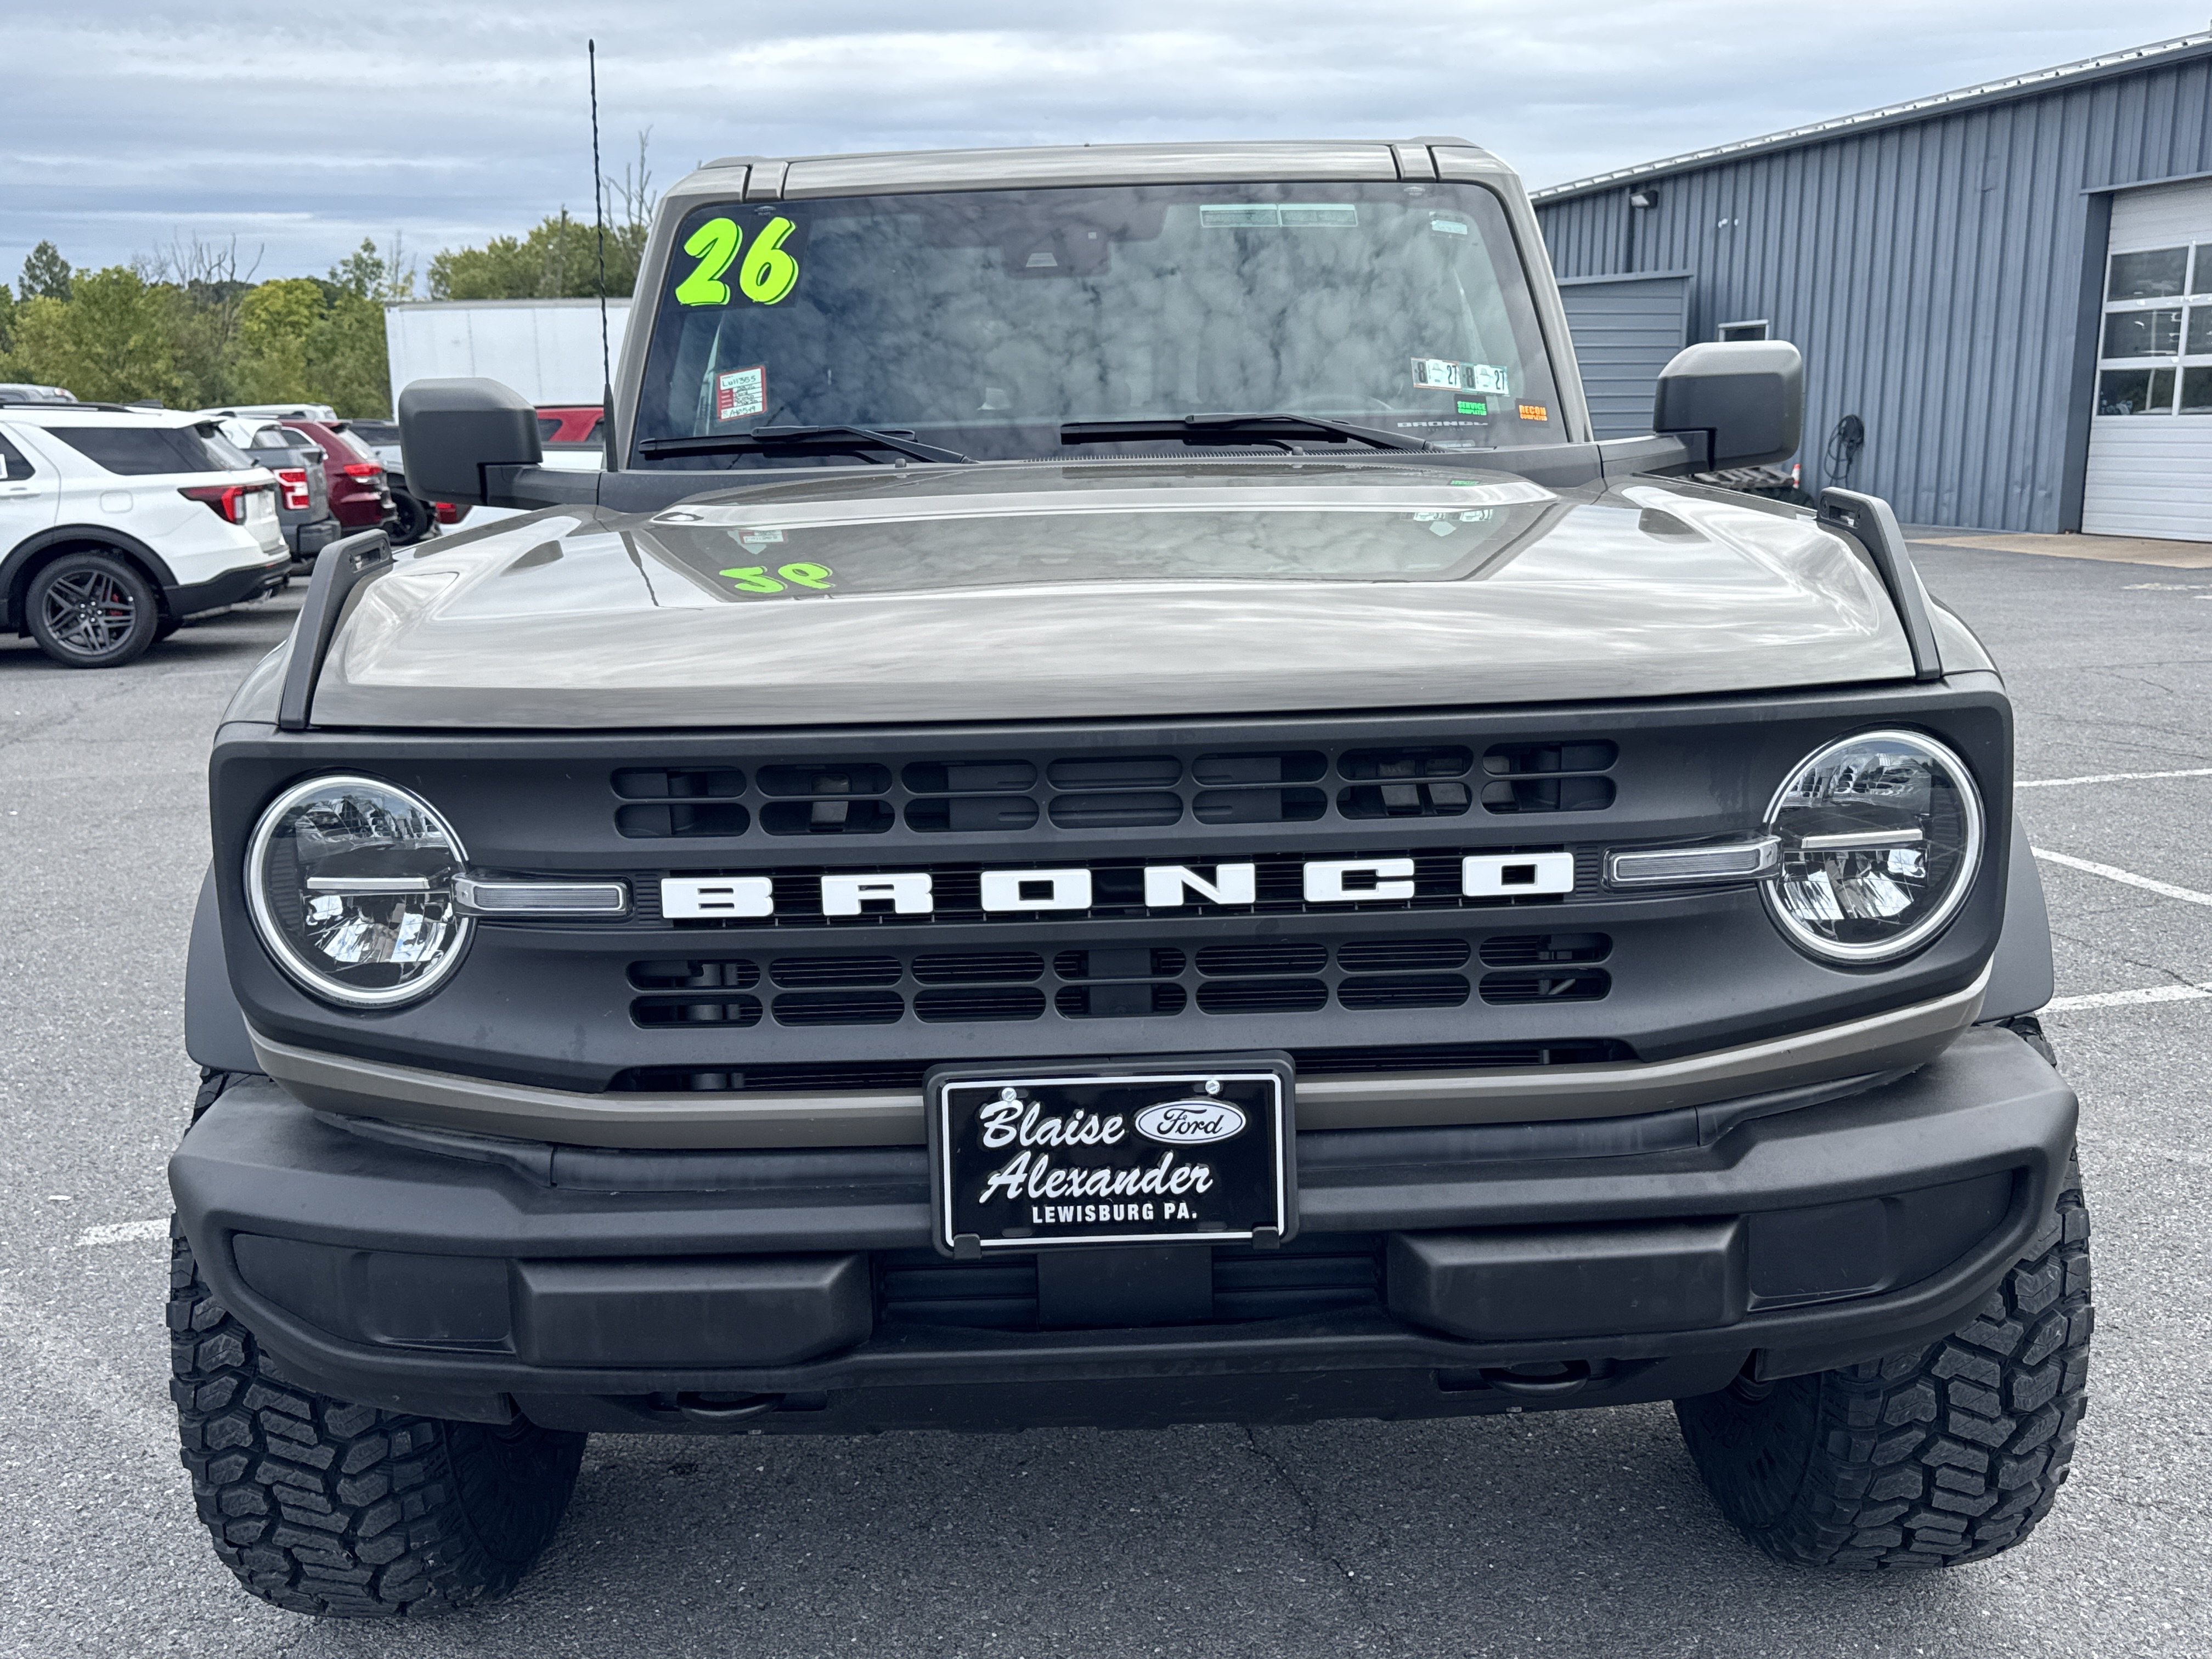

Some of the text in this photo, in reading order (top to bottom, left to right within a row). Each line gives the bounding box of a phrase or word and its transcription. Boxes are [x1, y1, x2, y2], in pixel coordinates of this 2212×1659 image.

[675, 216, 799, 306] 26
[1417, 362, 1457, 386] 8 27
[1465, 367, 1475, 387] 8
[1457, 401, 1486, 410] SERVICE
[1519, 405, 1546, 415] RECON
[661, 851, 1575, 919] BRONCO
[979, 1099, 1224, 1148] Blaise Ford
[979, 1150, 1213, 1203] Alexander
[1032, 1203, 1197, 1224] LEWISBURG PA.
